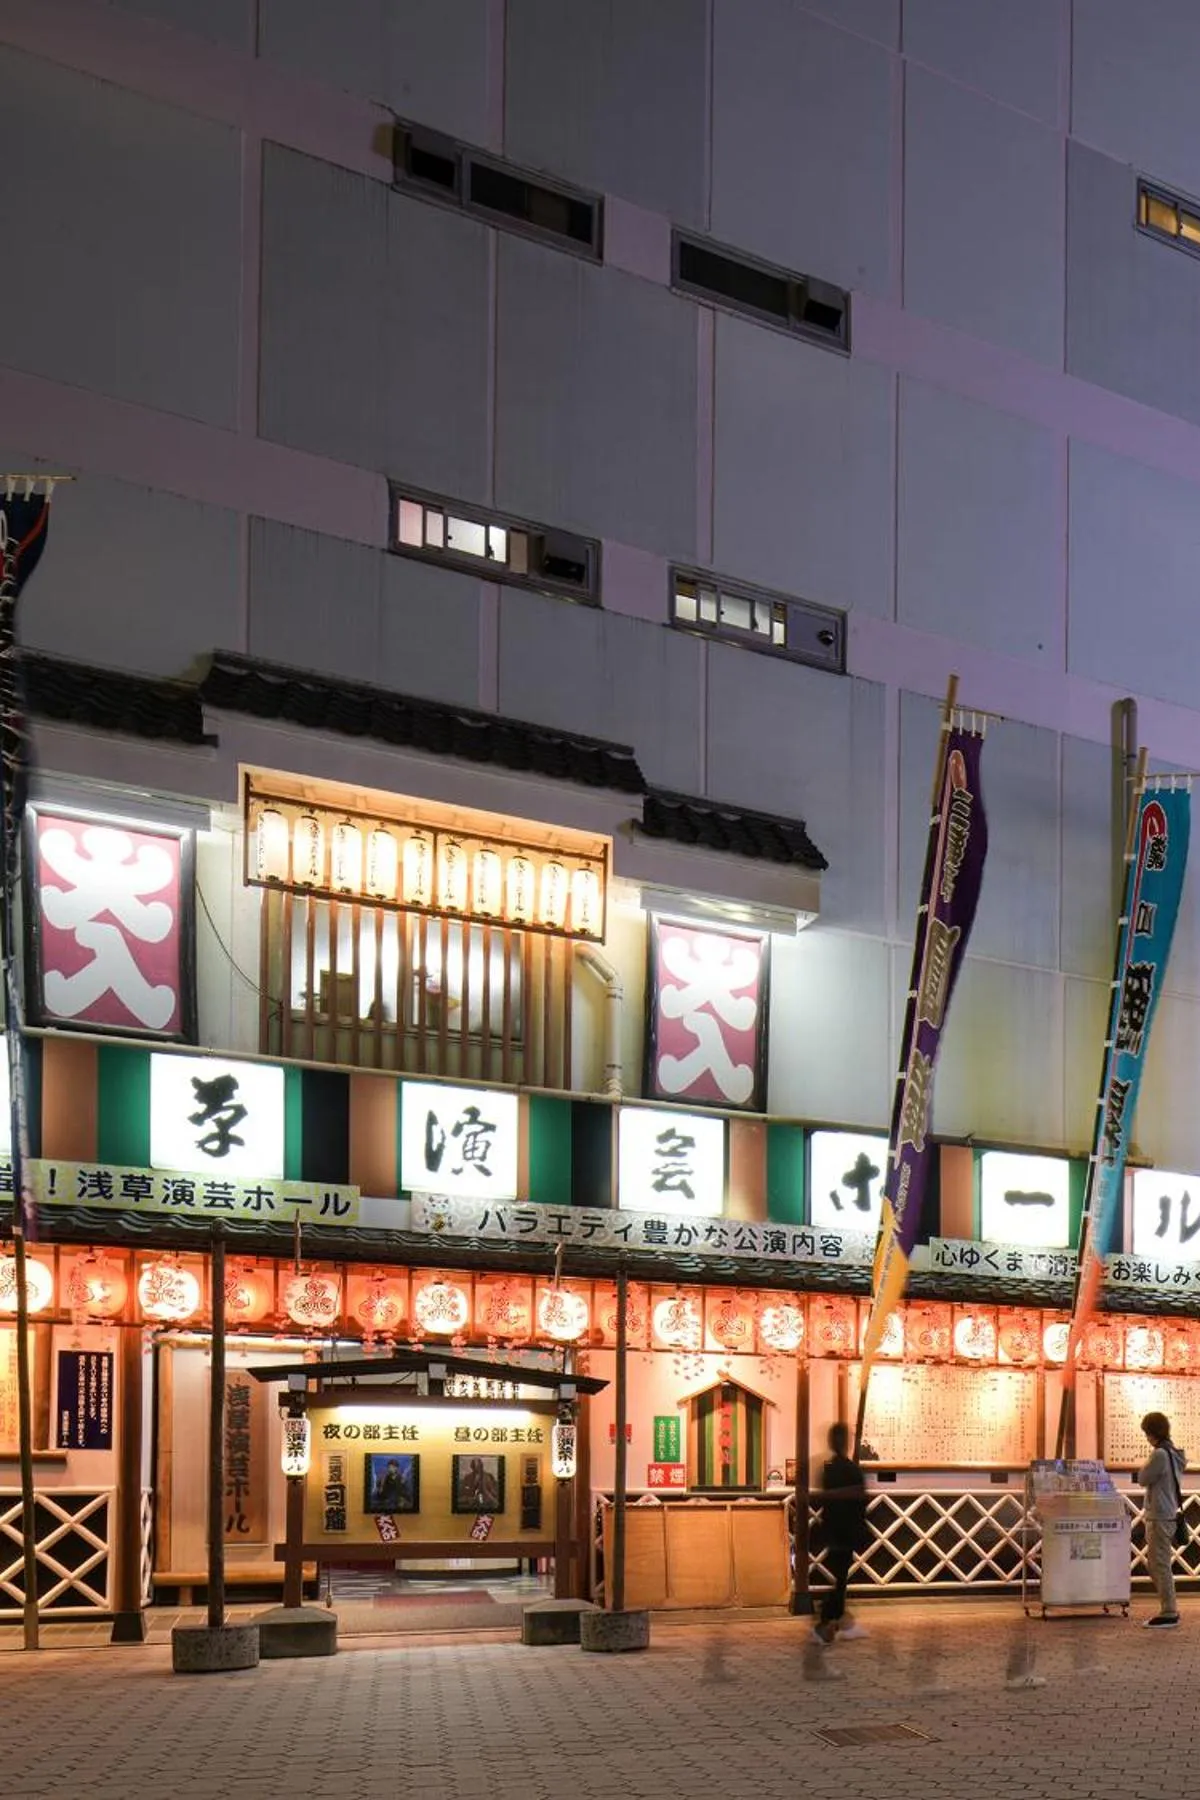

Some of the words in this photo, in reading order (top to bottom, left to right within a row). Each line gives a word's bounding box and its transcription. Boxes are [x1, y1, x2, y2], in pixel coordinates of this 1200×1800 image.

[478, 1206, 844, 1259] バラエティ豊かな公演内容
[323, 1423, 420, 1441] 夜の部主任
[453, 1426, 544, 1444] 昼の部主任
